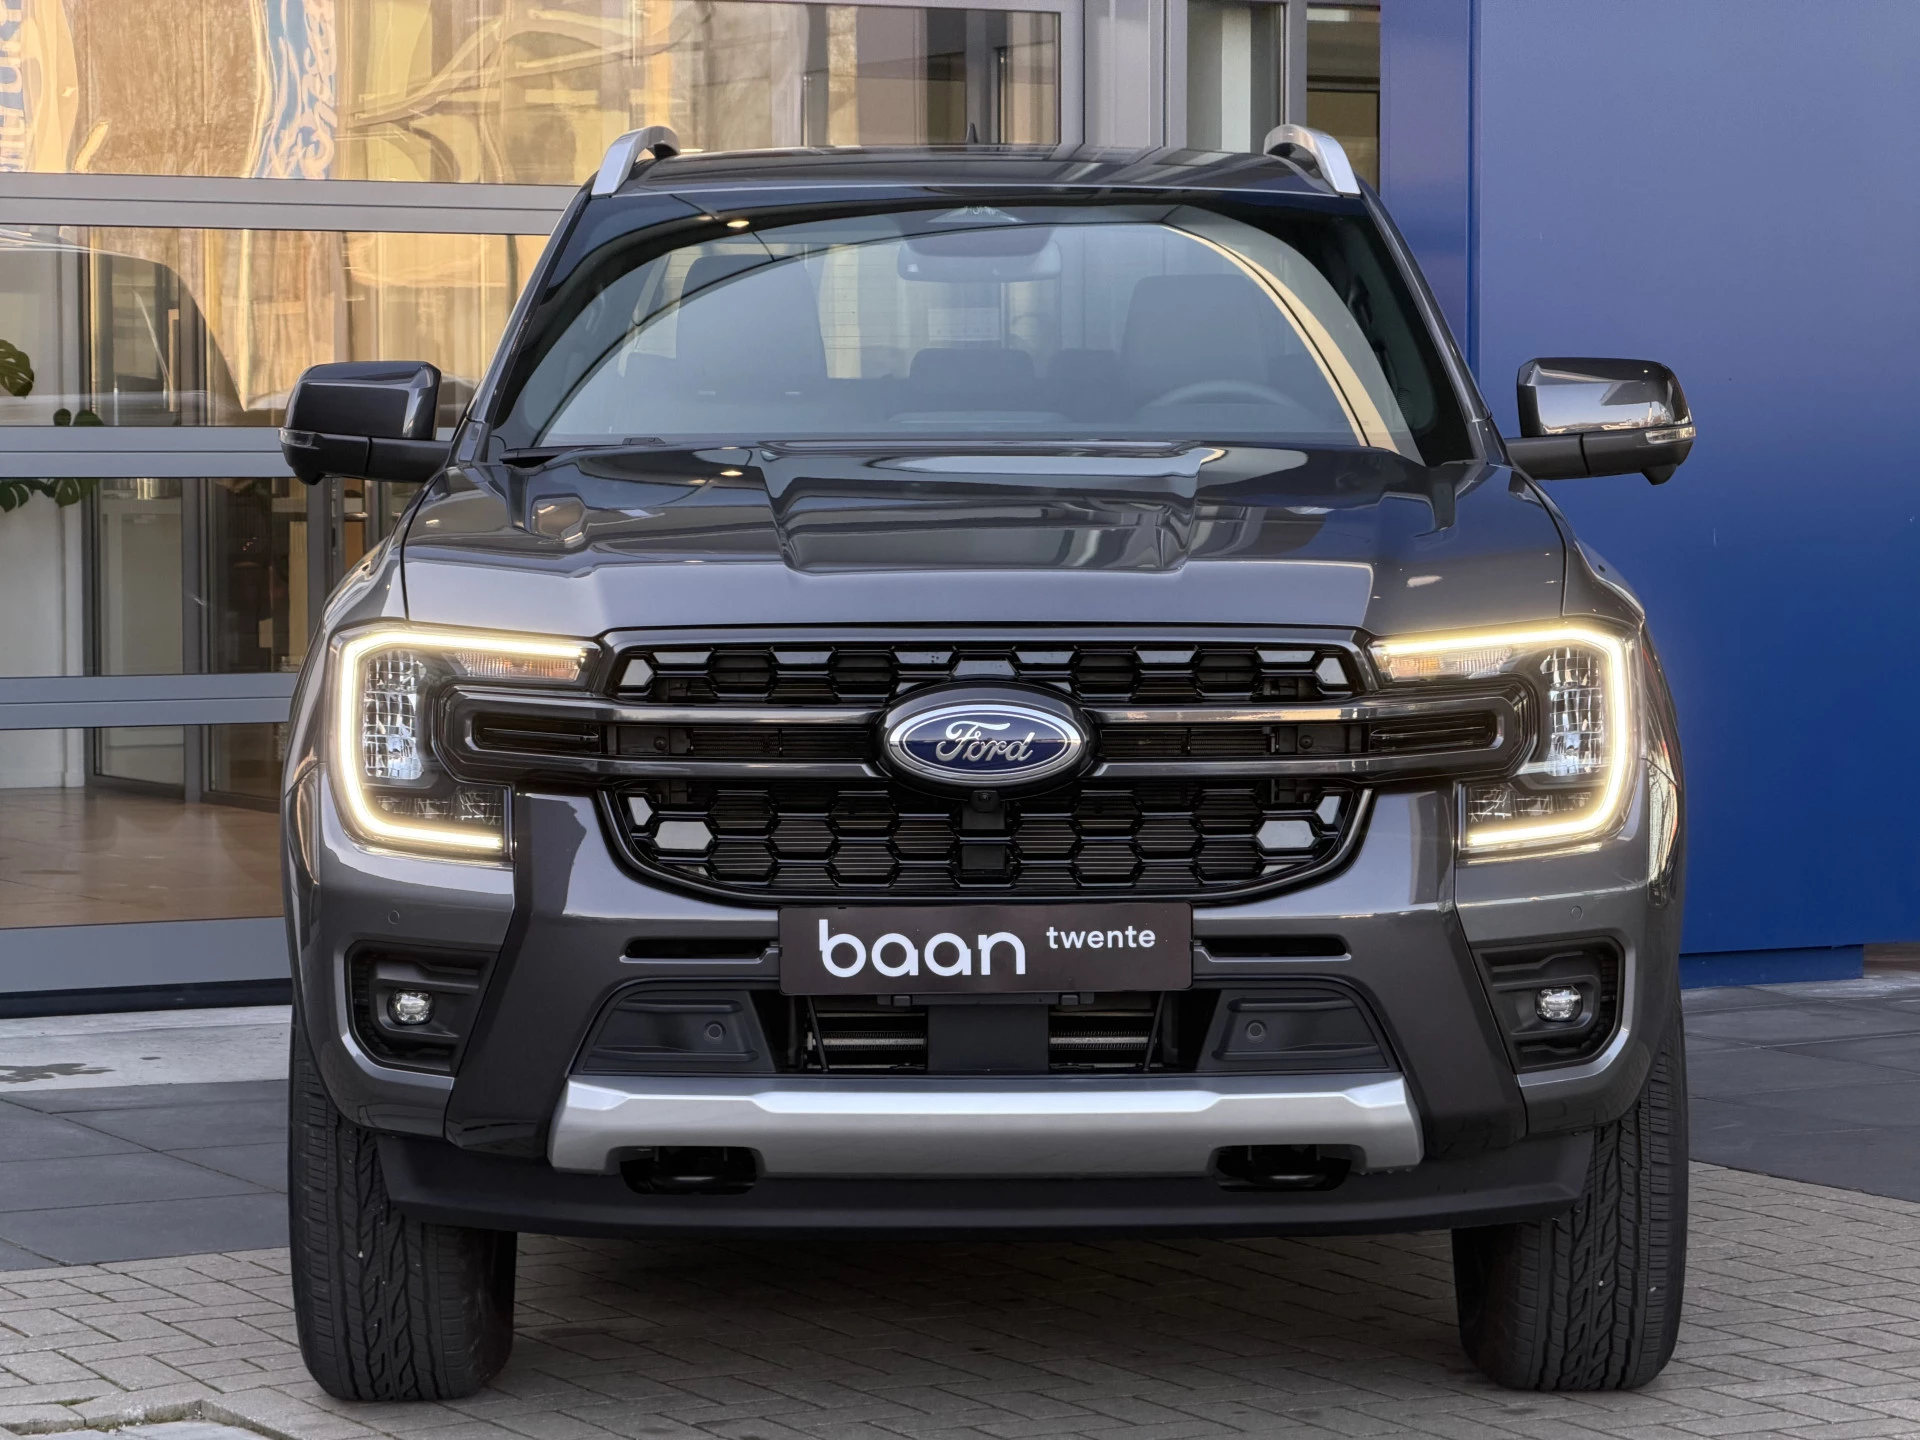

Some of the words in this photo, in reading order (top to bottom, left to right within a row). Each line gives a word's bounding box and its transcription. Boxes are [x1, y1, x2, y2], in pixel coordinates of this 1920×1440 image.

[935, 720, 1036, 762] Ford
[818, 919, 1026, 978] baan
[1046, 925, 1156, 949] twente
